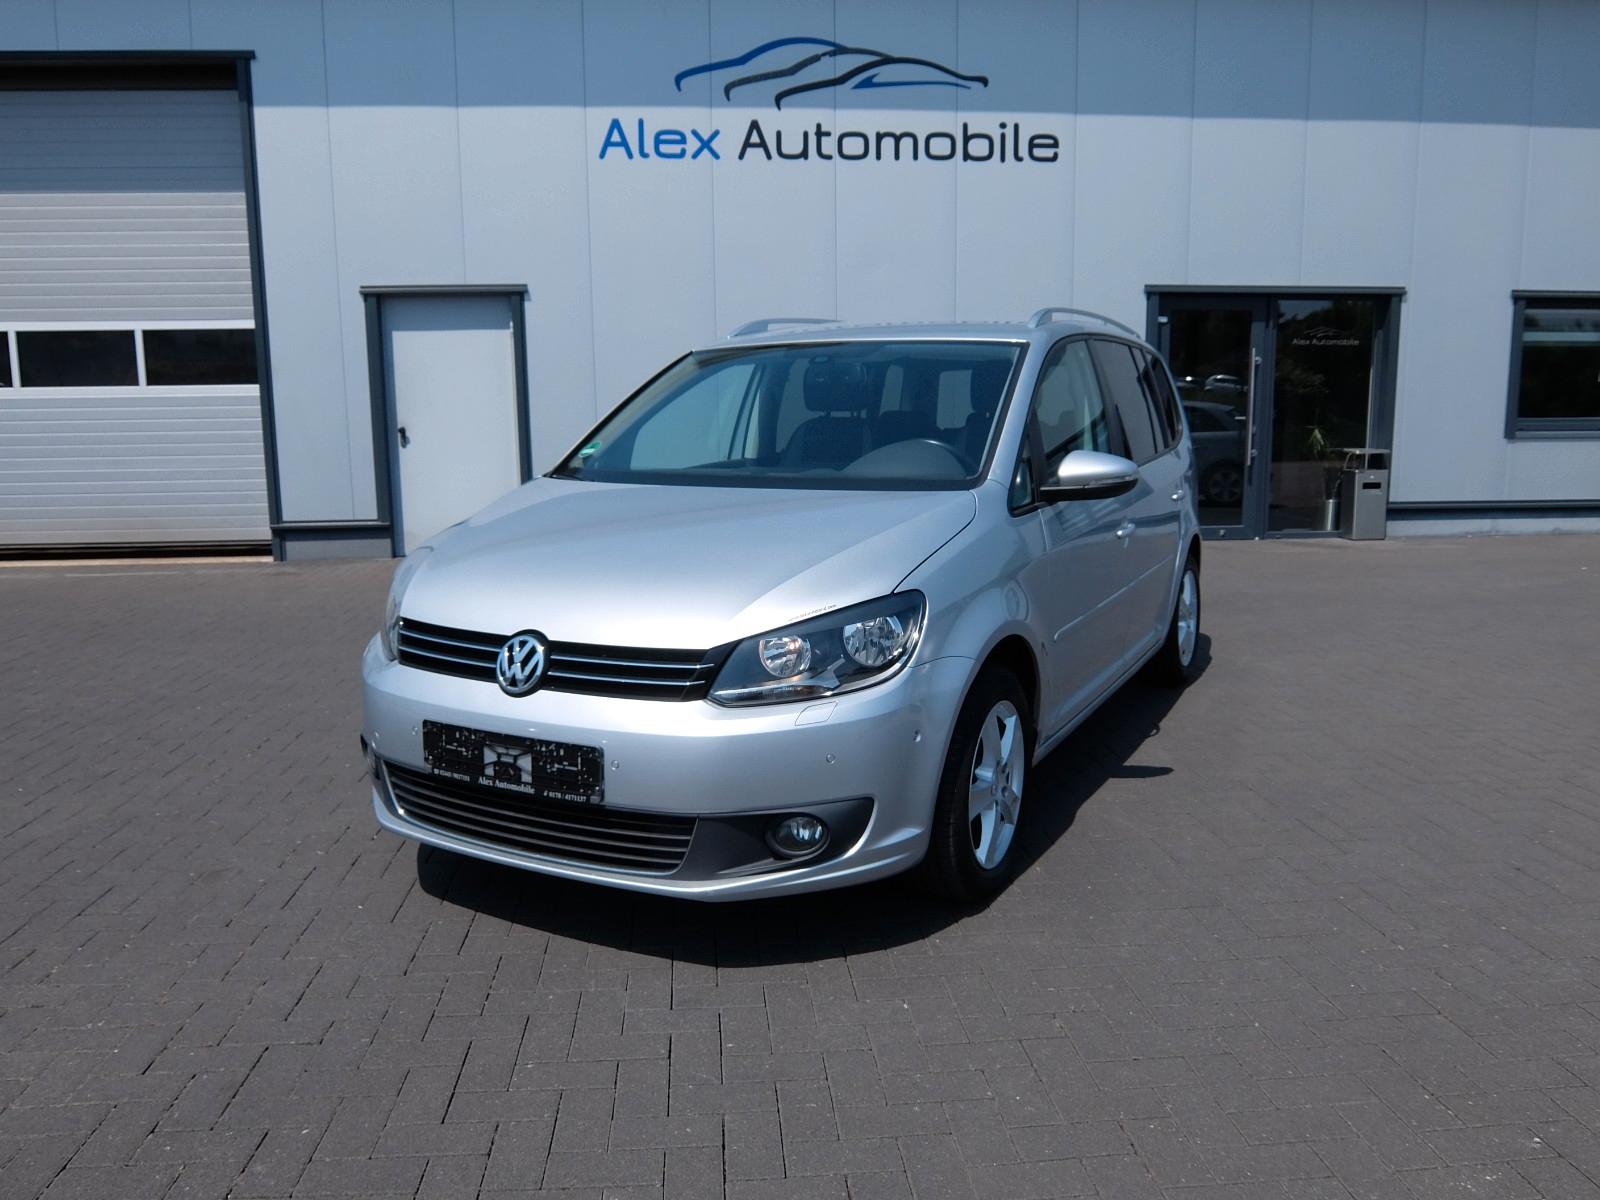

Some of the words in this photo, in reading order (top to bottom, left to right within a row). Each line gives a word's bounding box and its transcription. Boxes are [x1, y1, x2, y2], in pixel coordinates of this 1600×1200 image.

[599, 118, 721, 160] Alex
[738, 118, 1060, 163] Automobile
[1311, 338, 1360, 346] Automobile
[478, 776, 493, 786] Alex
[495, 779, 536, 795] Automobile
